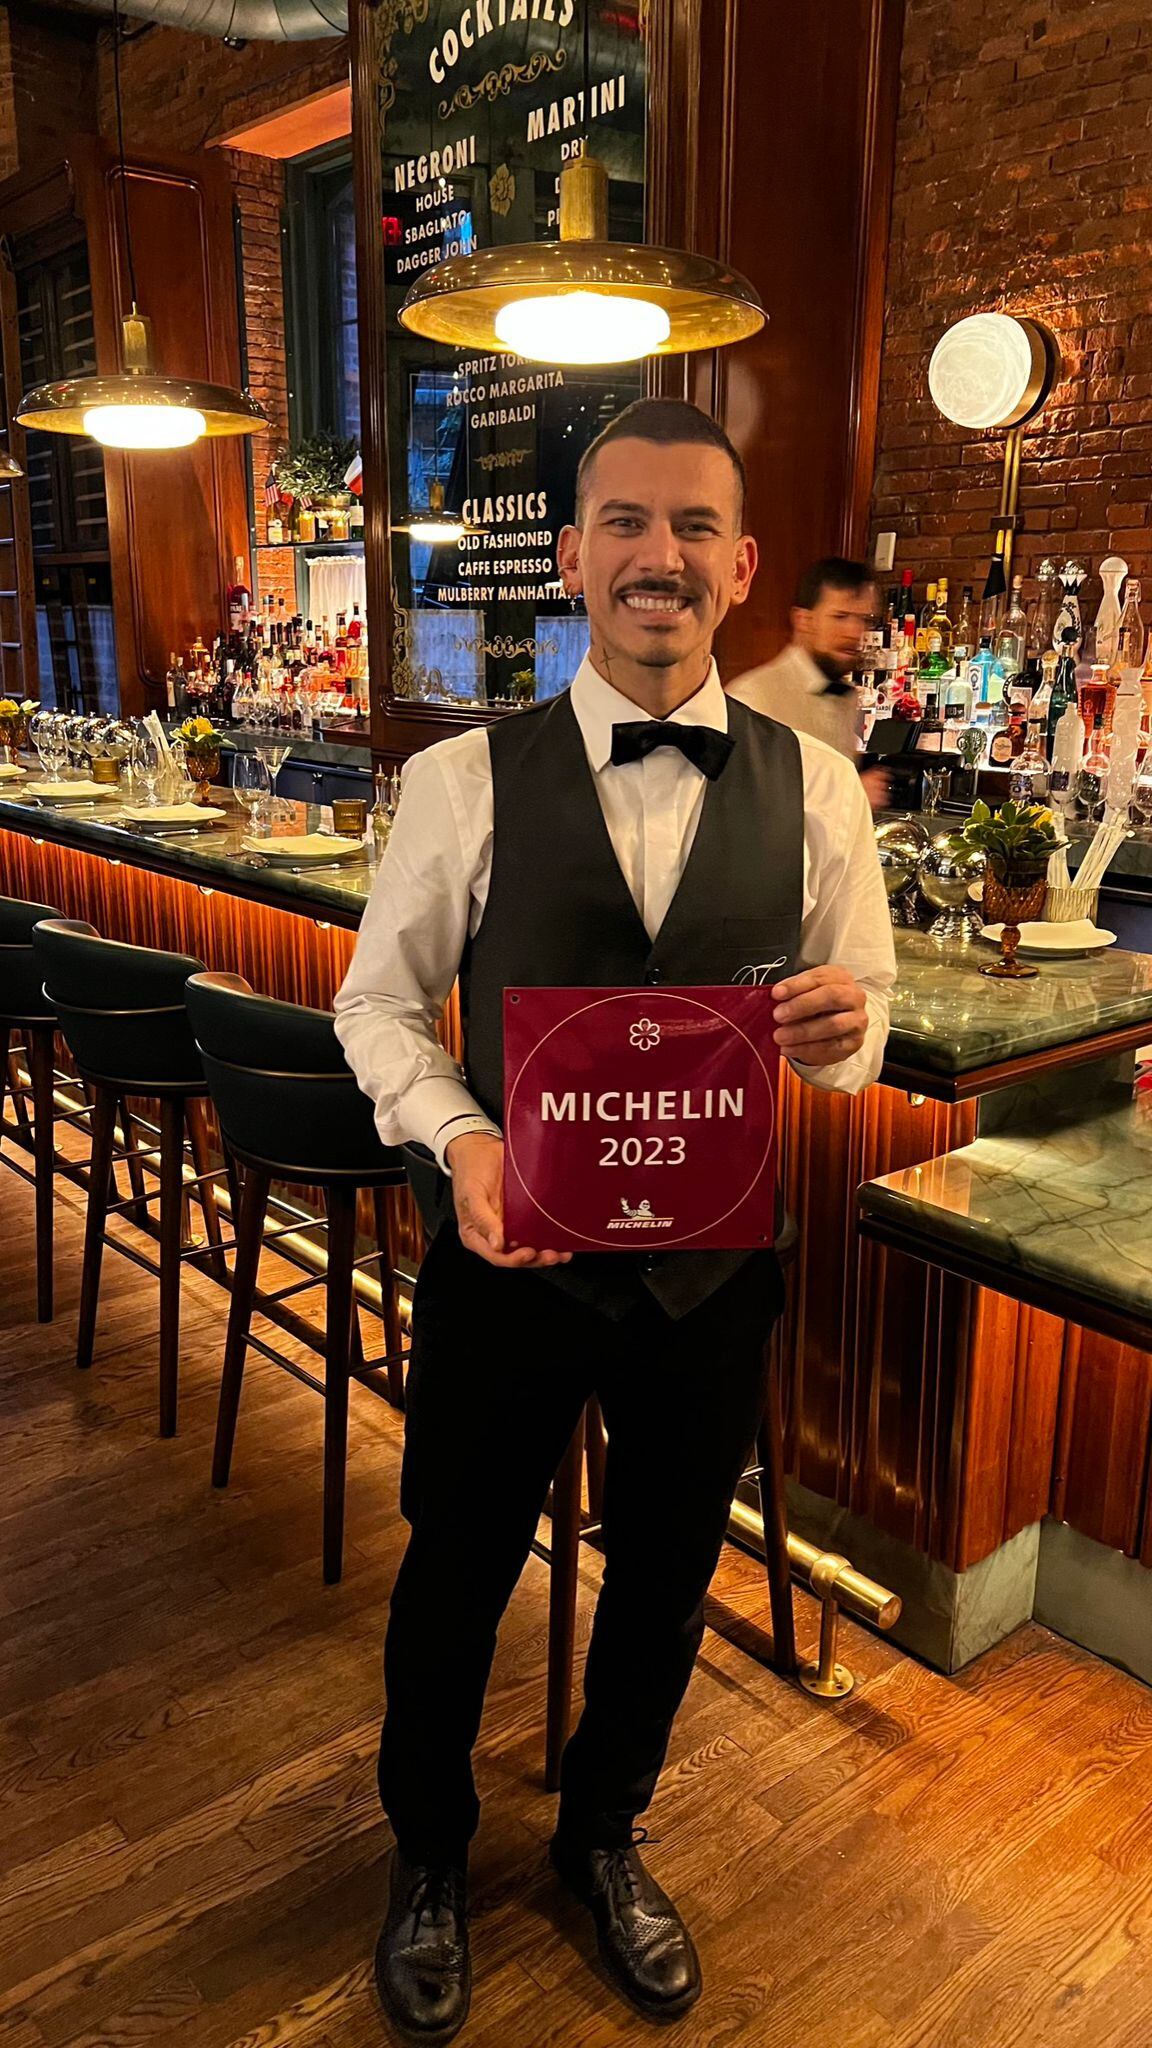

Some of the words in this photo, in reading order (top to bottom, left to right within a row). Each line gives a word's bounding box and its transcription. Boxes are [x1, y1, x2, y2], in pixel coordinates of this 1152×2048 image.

[429, 0, 574, 83] COCKTAILS
[527, 75, 625, 143] MARTINI
[394, 135, 476, 193] NEGRONI
[416, 184, 455, 213] HOUSE
[405, 209, 467, 245] SBAGLIATO
[397, 247, 442, 274] DAGGER
[444, 235, 477, 259] JOHN
[458, 356, 497, 378] SPRITZ
[446, 386, 486, 408] ROCCO
[489, 370, 564, 400] MARGARITA
[471, 404, 536, 430] GARIBALDI
[462, 491, 547, 525] CLASSICS
[457, 536, 480, 551] OLD
[483, 530, 553, 549] FASHIONED
[458, 561, 491, 576] CAFFE
[493, 558, 552, 575] ESPRESSO
[437, 586, 495, 602] MULBERRY
[498, 585, 577, 600] MANHATTA
[540, 1088, 744, 1121] MICHELIN
[598, 1136, 687, 1166] 2023
[606, 1220, 674, 1229] MICHELIN
